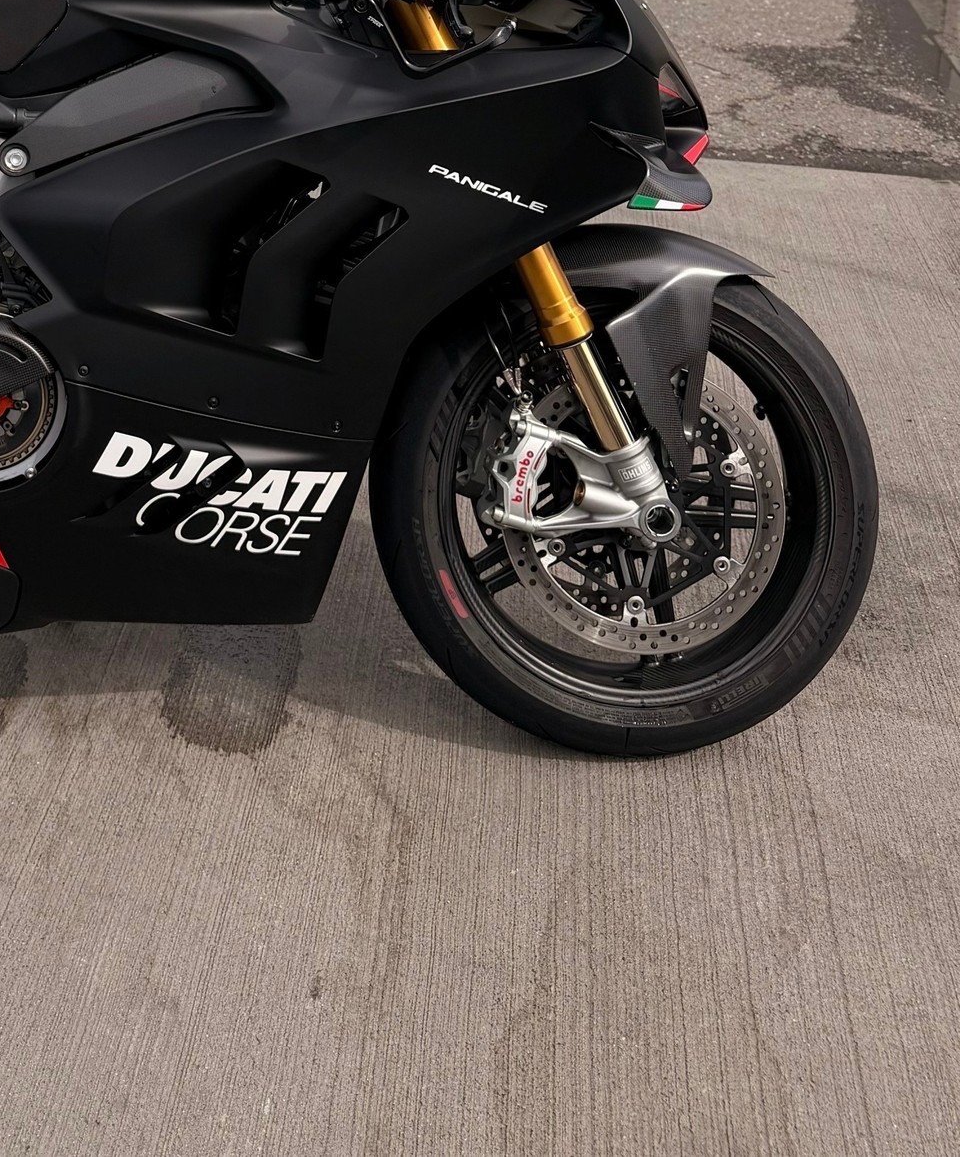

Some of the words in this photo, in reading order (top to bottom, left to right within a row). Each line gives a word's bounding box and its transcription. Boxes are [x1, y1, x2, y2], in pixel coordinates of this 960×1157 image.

[428, 164, 549, 214] PANIGALE
[92, 431, 348, 514] DUCATI
[511, 450, 535, 503] brembo
[621, 460, 652, 481] ÖHLINS
[135, 492, 323, 556] CORSE
